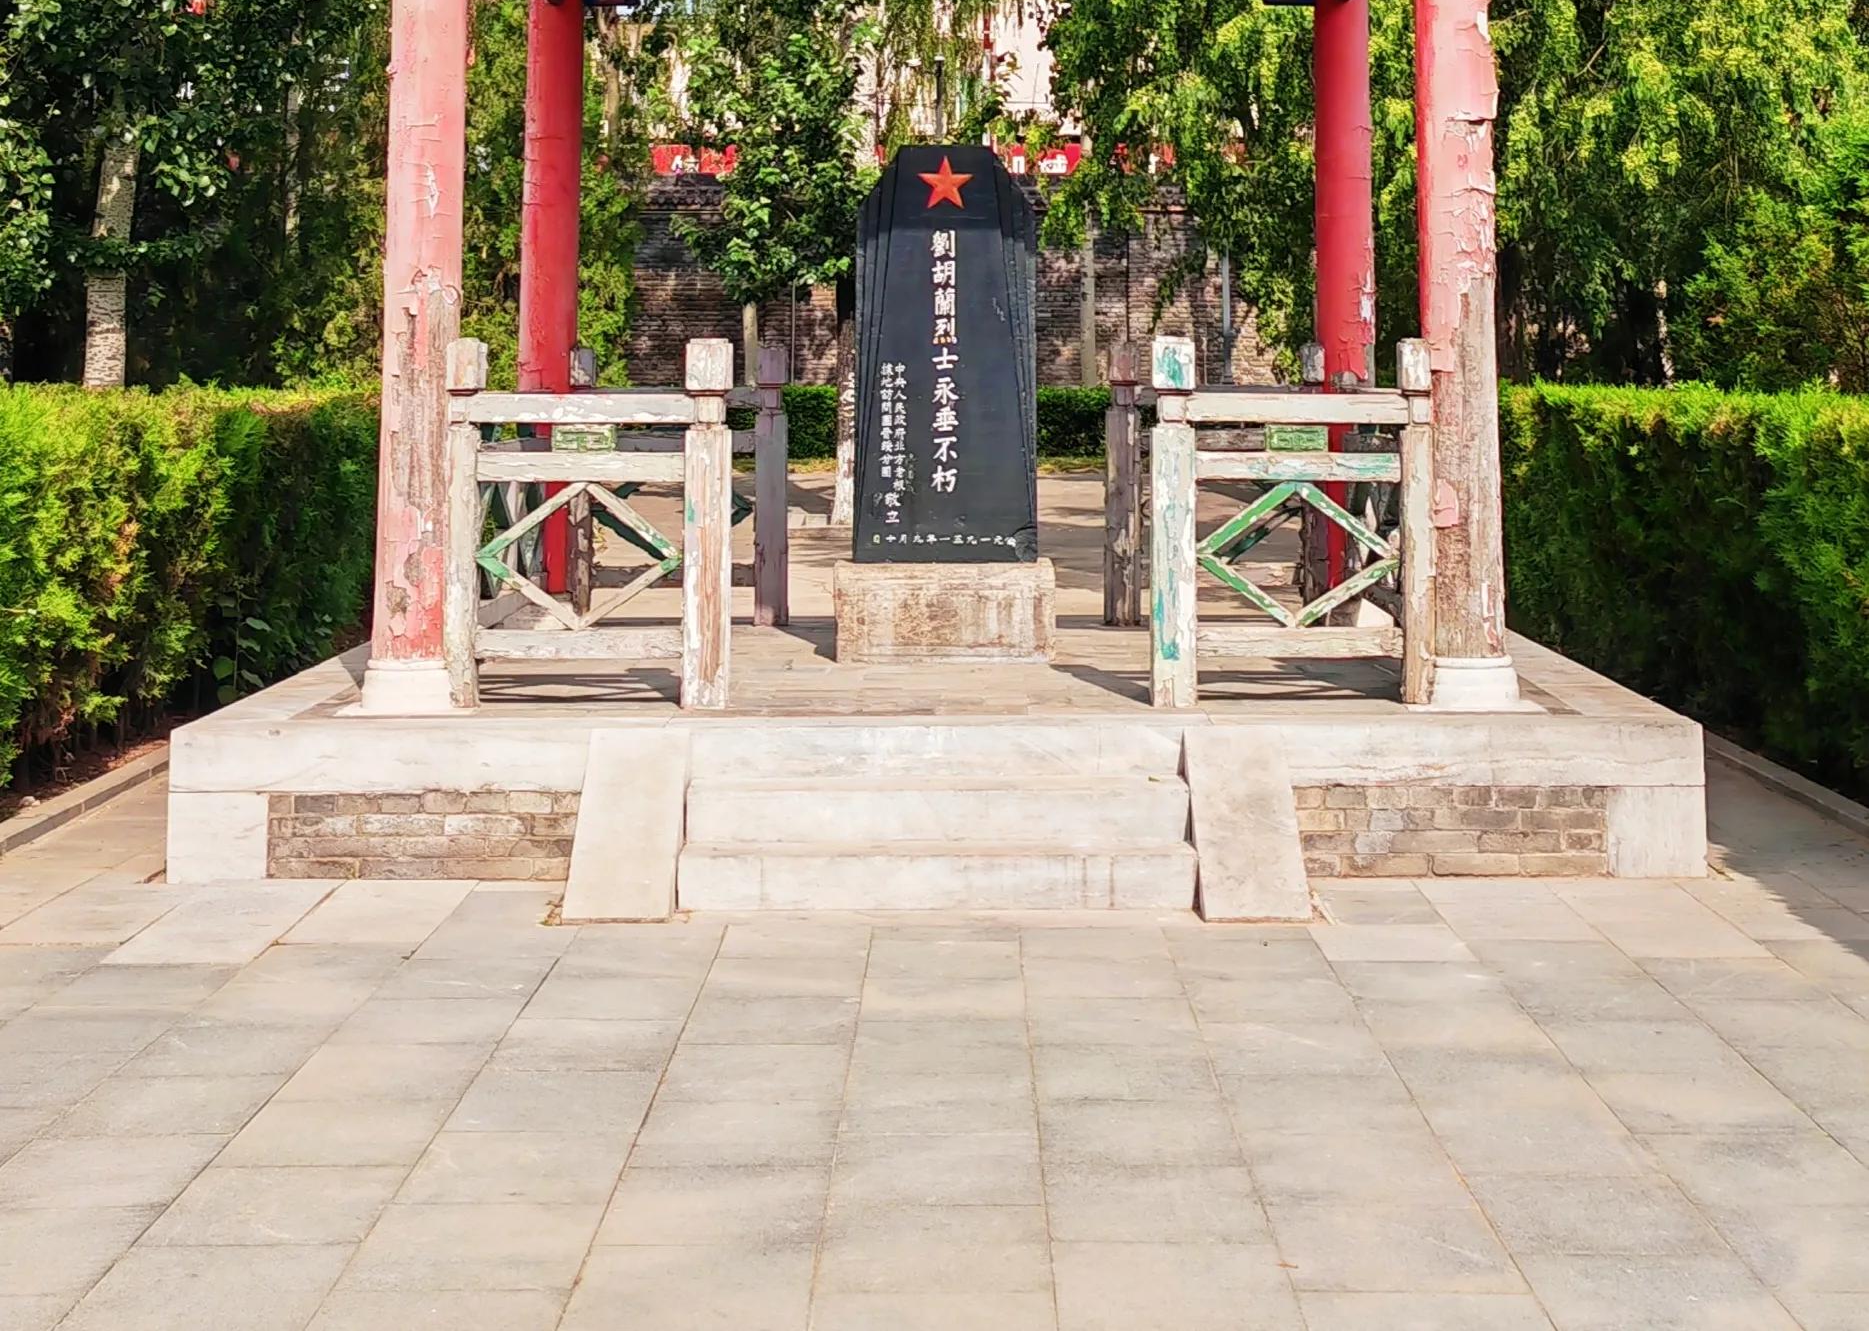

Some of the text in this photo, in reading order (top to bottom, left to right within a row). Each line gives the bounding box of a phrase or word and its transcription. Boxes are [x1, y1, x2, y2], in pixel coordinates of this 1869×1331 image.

[930, 230, 959, 492] 劉胡蘭烈士永垂不朽
